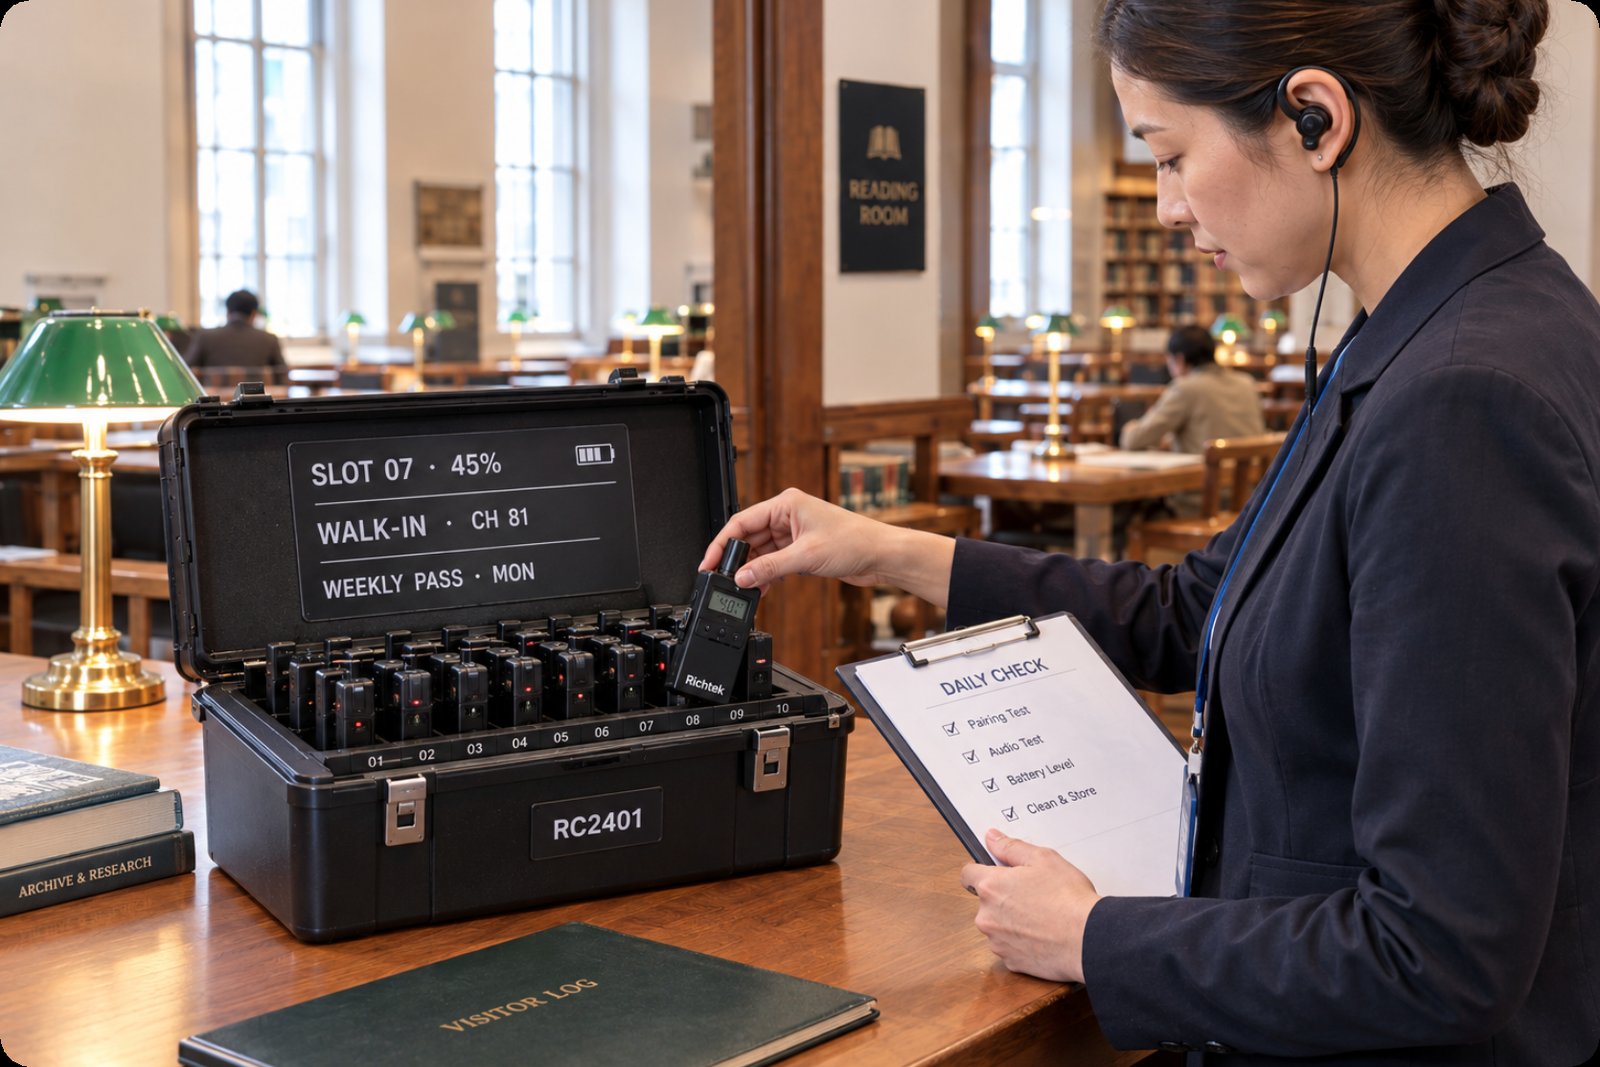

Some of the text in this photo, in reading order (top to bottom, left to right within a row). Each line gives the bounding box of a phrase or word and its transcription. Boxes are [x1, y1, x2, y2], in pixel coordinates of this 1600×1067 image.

[849, 179, 919, 201] READING
[859, 205, 909, 225] ROOM
[311, 459, 374, 486] SLOT
[384, 457, 414, 480] 07
[451, 451, 502, 476] 45%
[317, 514, 427, 545] WALK-IN
[471, 509, 499, 530] CH
[508, 507, 529, 527] 81
[322, 573, 403, 600] WEEKLY
[414, 568, 464, 591] PASS
[492, 561, 536, 584] MON
[685, 674, 726, 696] Richtek
[939, 657, 1050, 696] DAILY CHECK
[967, 705, 1031, 730] Pairing Test
[368, 703, 790, 768] 01 02 03 04 05 06 07 08 09 10
[988, 734, 1044, 758] Audio Test
[1006, 758, 1075, 786] Battery Level
[1026, 786, 1098, 815] Clean & Store
[553, 807, 642, 840] RC2401
[18, 855, 152, 898] ARCHIVE & RESEARCH
[439, 978, 599, 1033] VISITOR LOG
